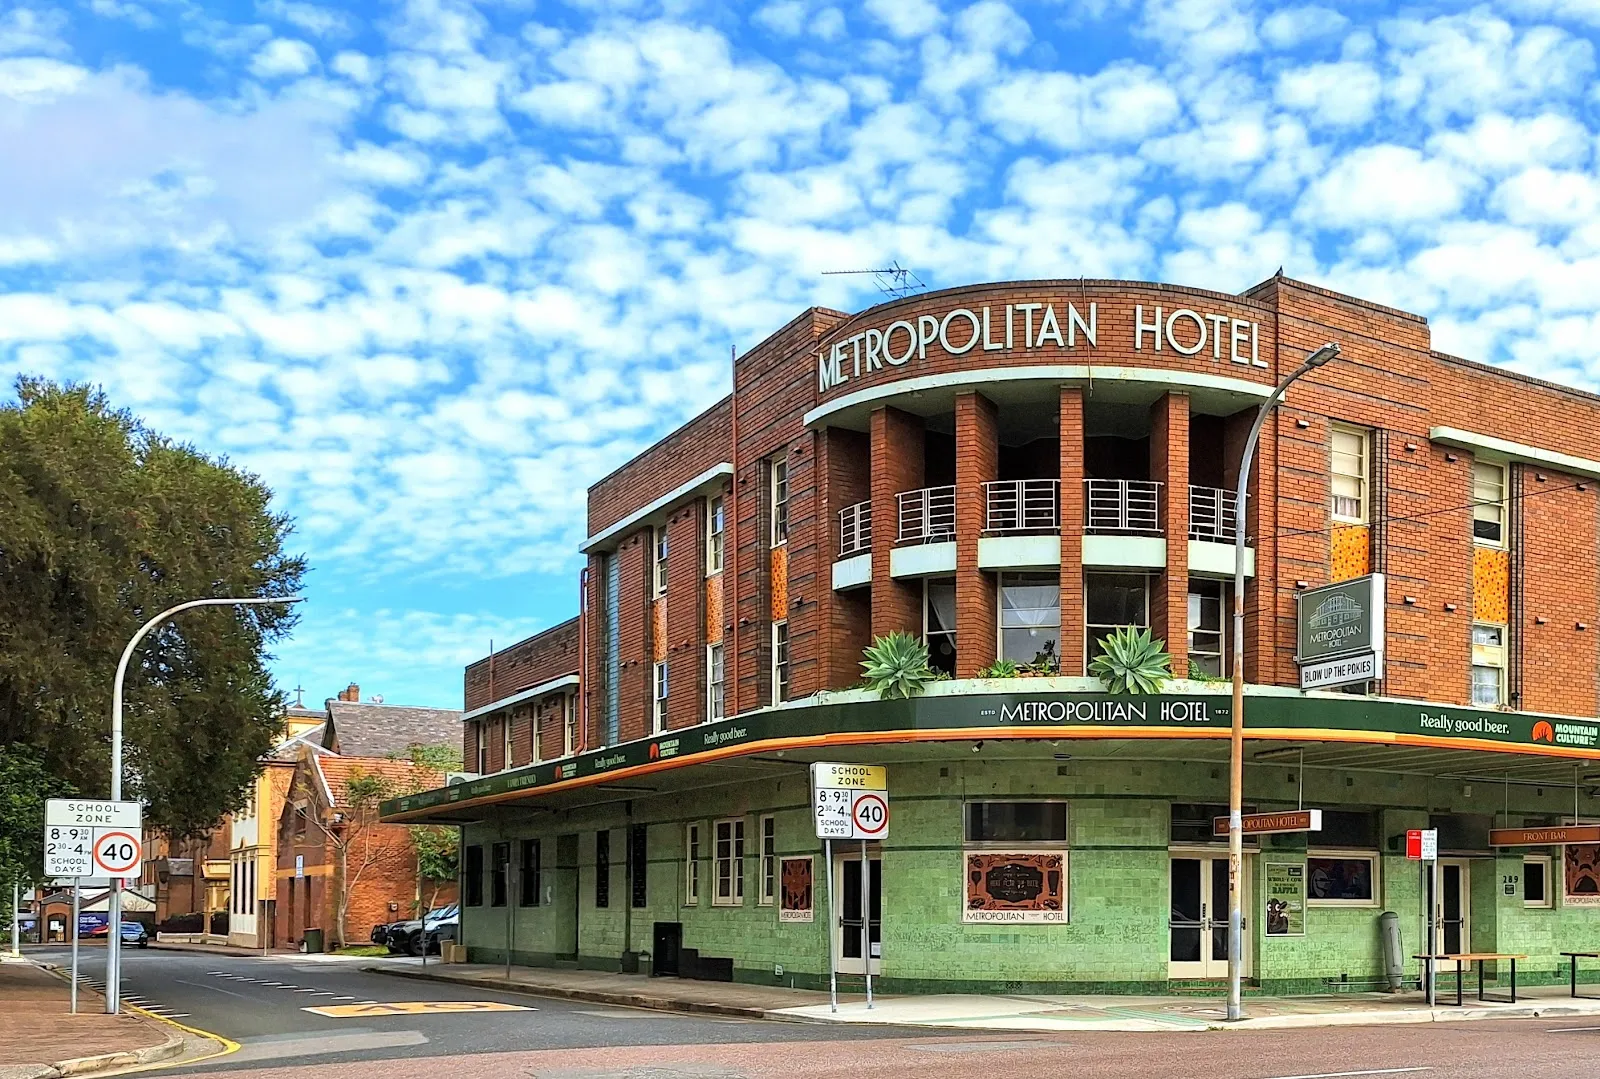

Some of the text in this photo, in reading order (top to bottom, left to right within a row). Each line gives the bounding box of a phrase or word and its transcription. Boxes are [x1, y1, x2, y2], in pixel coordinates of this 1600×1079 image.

[818, 301, 1269, 393] METROPOLITAN HOTEL
[1310, 624, 1362, 644] METROPOLITAN
[1304, 660, 1371, 682] BLOW UP THE POKIES
[1000, 701, 1146, 722] METROPOLITAN
[1160, 702, 1210, 722] HOTEL
[1420, 713, 1510, 734] Really good beer.
[1555, 724, 1598, 736] MOUNTAIN
[704, 727, 748, 745] Really good beer.
[1556, 734, 1588, 745] CULTURE
[832, 766, 872, 776] SCHOOL
[838, 778, 866, 786] ZONE
[68, 804, 120, 812] SCHOOL
[76, 814, 112, 823] ZONE
[860, 806, 882, 822] 40
[1276, 816, 1298, 827] HOTEL
[1524, 831, 1567, 840] FRONT BAR
[102, 844, 133, 860] 40
[1502, 876, 1518, 884] 289
[1272, 886, 1298, 894] RAFFLE
[966, 912, 1024, 920] METROPOLITAN
[1043, 912, 1064, 920] HOTEL
